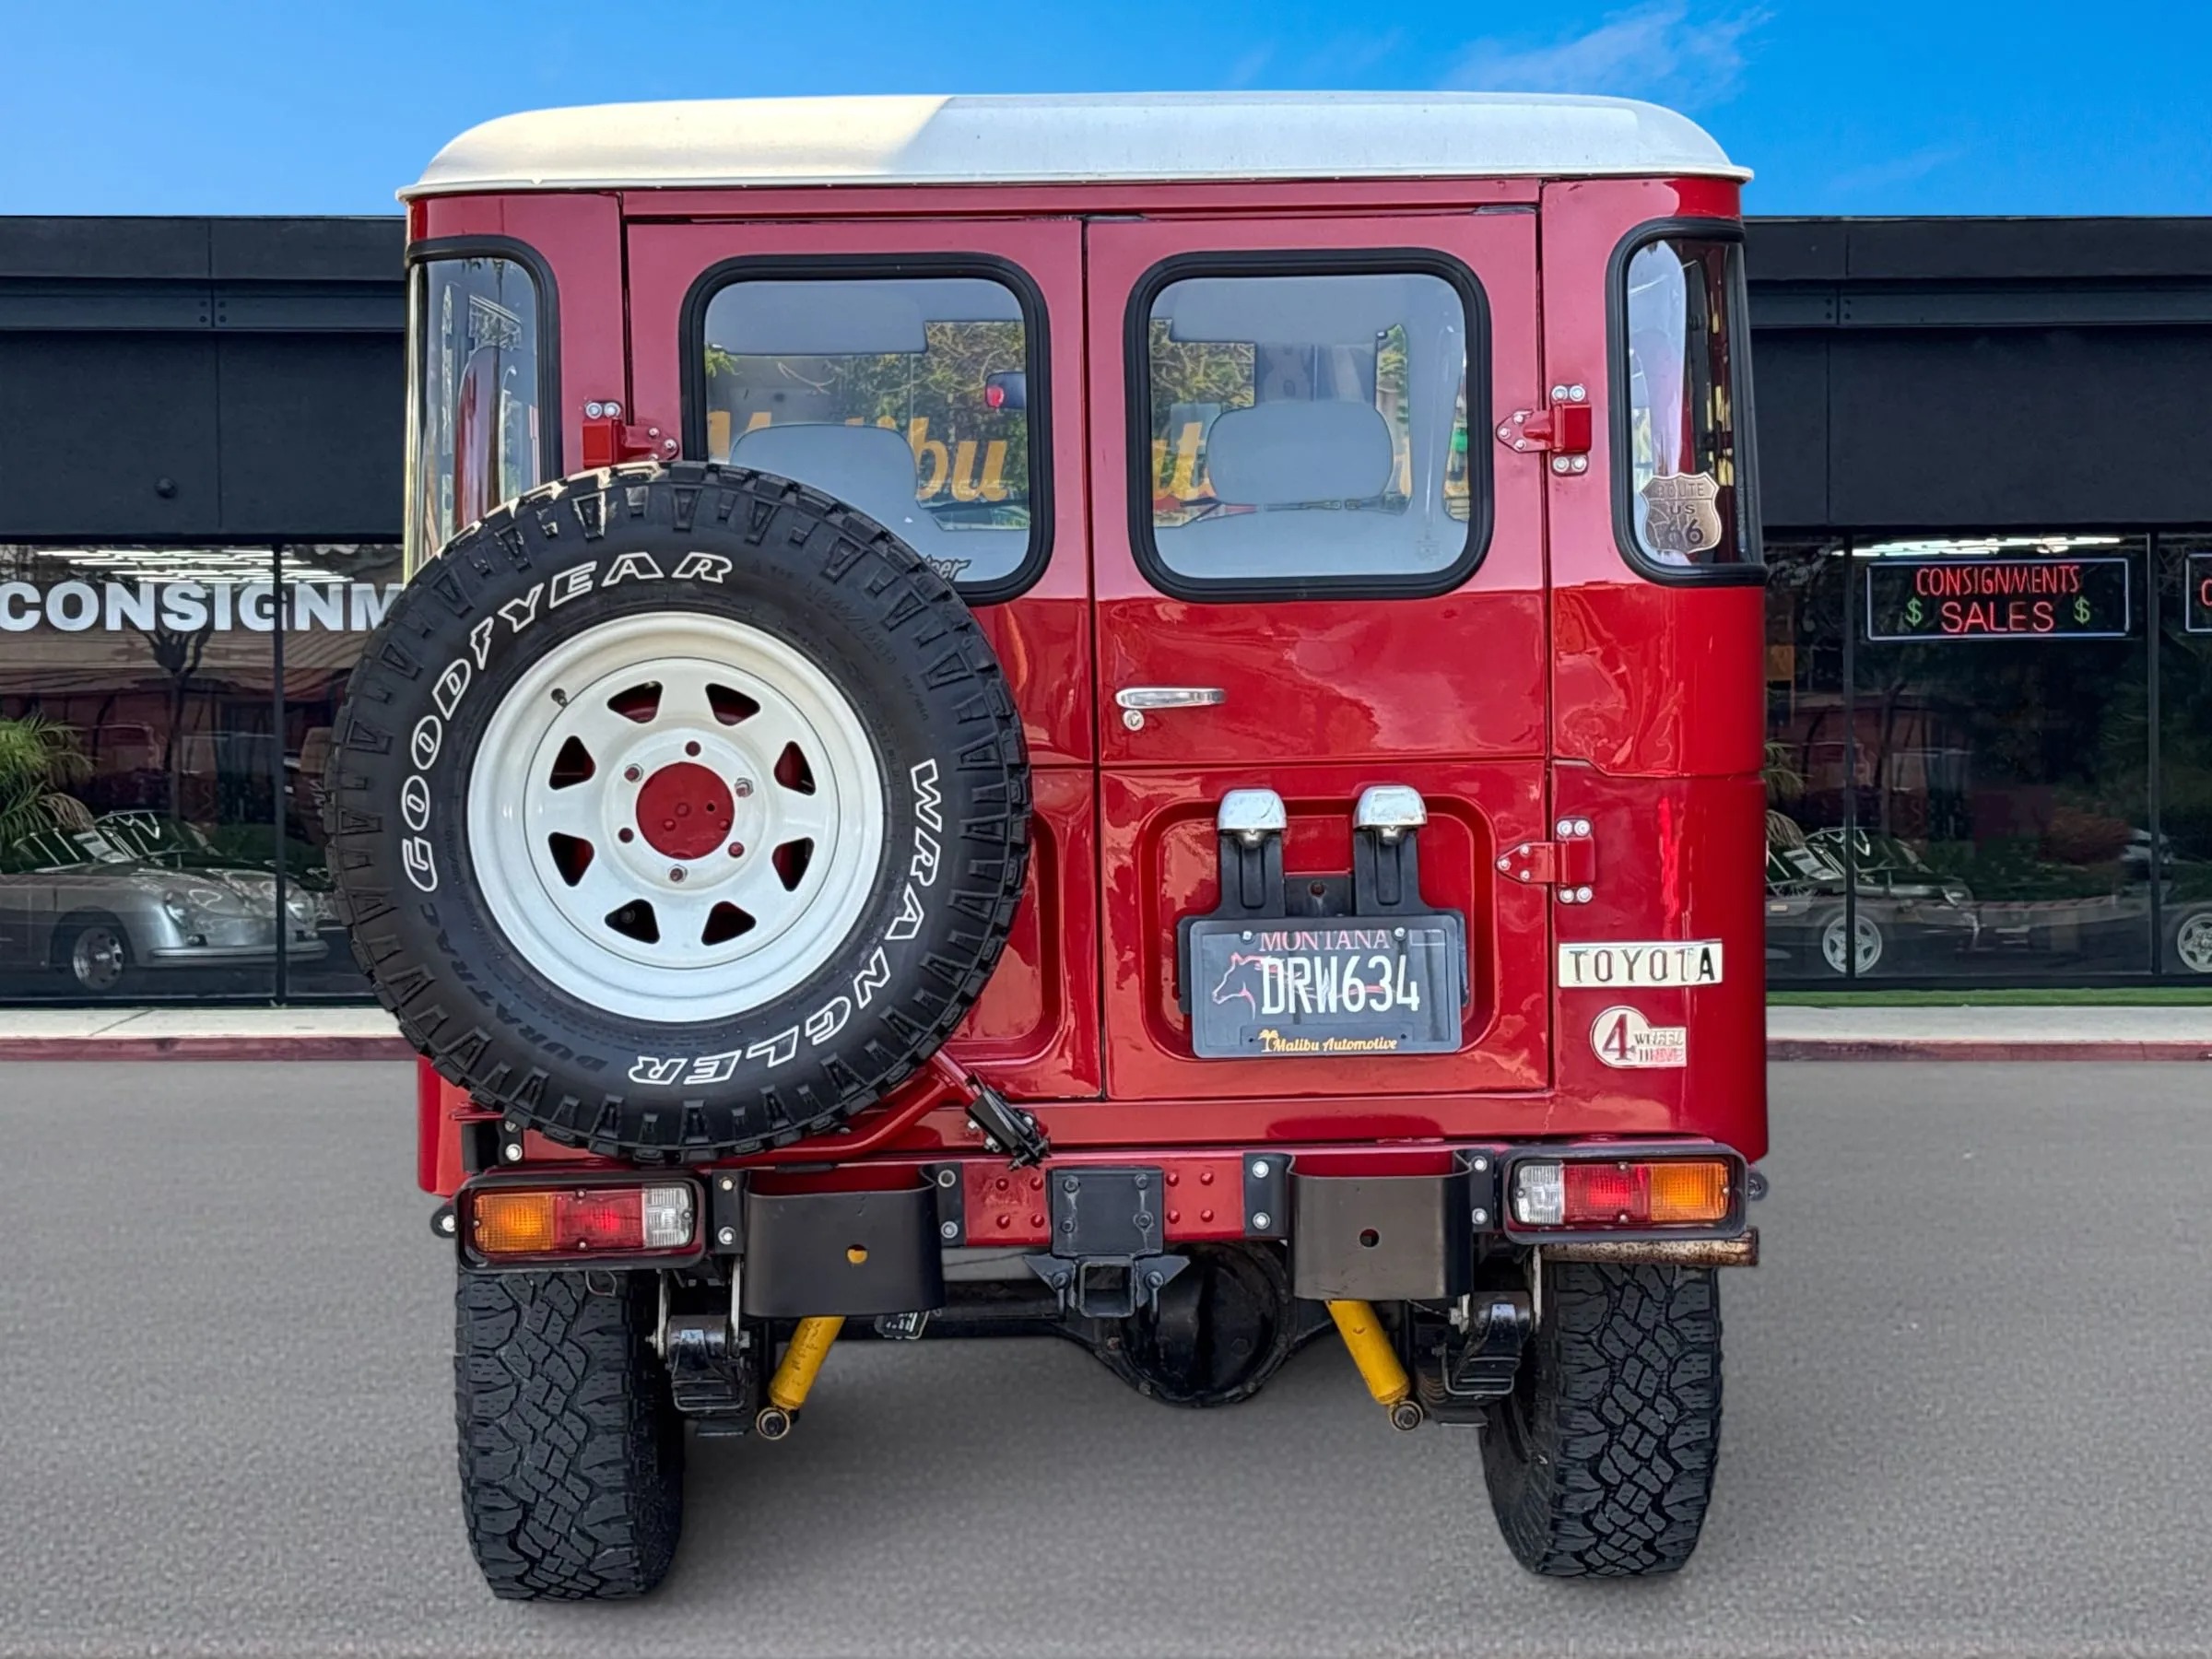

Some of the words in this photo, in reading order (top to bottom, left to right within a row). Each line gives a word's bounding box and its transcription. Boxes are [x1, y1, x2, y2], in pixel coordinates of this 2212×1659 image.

[1916, 565, 2081, 596] CONSIGNMENTS
[1941, 601, 2054, 633] SALES
[402, 552, 733, 892] GOODYEAR
[628, 759, 942, 1086] WRANGLER
[1259, 929, 1391, 952] MONTANA
[1569, 947, 1715, 982] TOYOTA
[1261, 954, 1420, 1014] DRW634
[1273, 1037, 1319, 1052] Malibu
[1322, 1035, 1398, 1052] Automotive
[1602, 1013, 1636, 1061] 4
